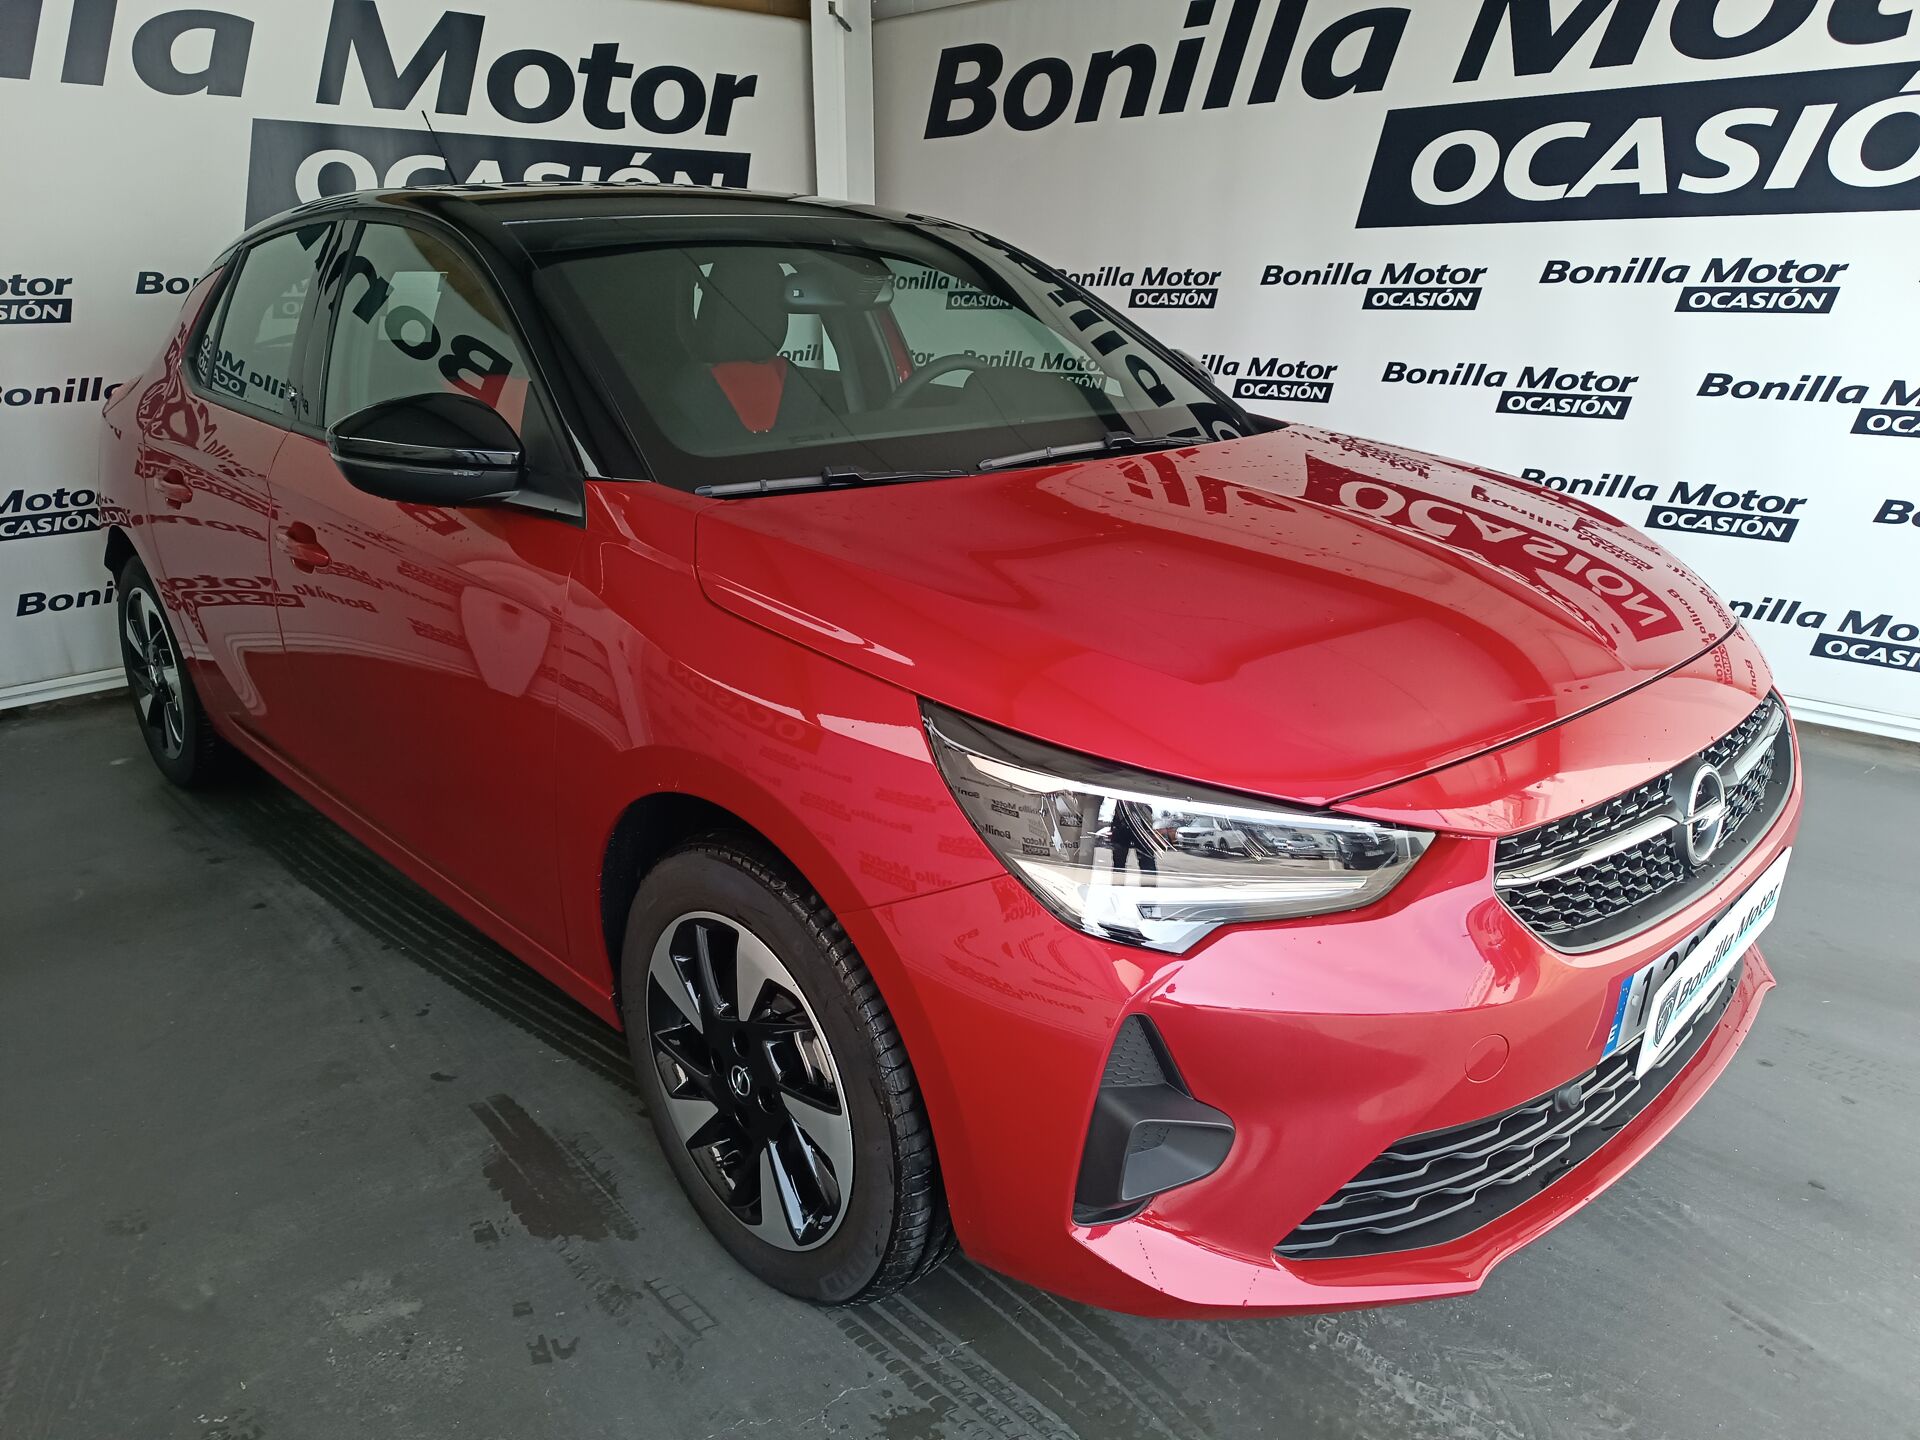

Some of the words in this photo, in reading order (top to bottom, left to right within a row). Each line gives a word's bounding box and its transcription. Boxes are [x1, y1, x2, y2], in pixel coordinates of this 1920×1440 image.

[316, 0, 757, 136] Motor
[924, 0, 1411, 139] Bonilla
[894, 271, 949, 290] onilla
[1141, 267, 1222, 286] Motor
[1260, 263, 1373, 285] Bonilla
[1379, 263, 1488, 285] Motor
[1538, 257, 1690, 284] Bonilla
[1700, 258, 1849, 283] Motor
[1135, 289, 1212, 307] OCASIÓN
[1372, 288, 1473, 307] OCASIÓN
[1688, 289, 1828, 310] OCASIÓN
[1246, 358, 1338, 380] Motor
[1381, 361, 1508, 387] Bonilla
[1516, 366, 1639, 393] Motor
[1239, 380, 1327, 401] OCASIÓN
[1696, 373, 1870, 404] Bonilla
[1507, 395, 1622, 416] OCASIÓN
[1521, 468, 1658, 501] Bonilla
[1667, 482, 1807, 514] Motor
[1657, 511, 1787, 538] OCASIÓN
[1676, 933, 1734, 1010] Bonilla
[1735, 883, 1779, 943] Motor
